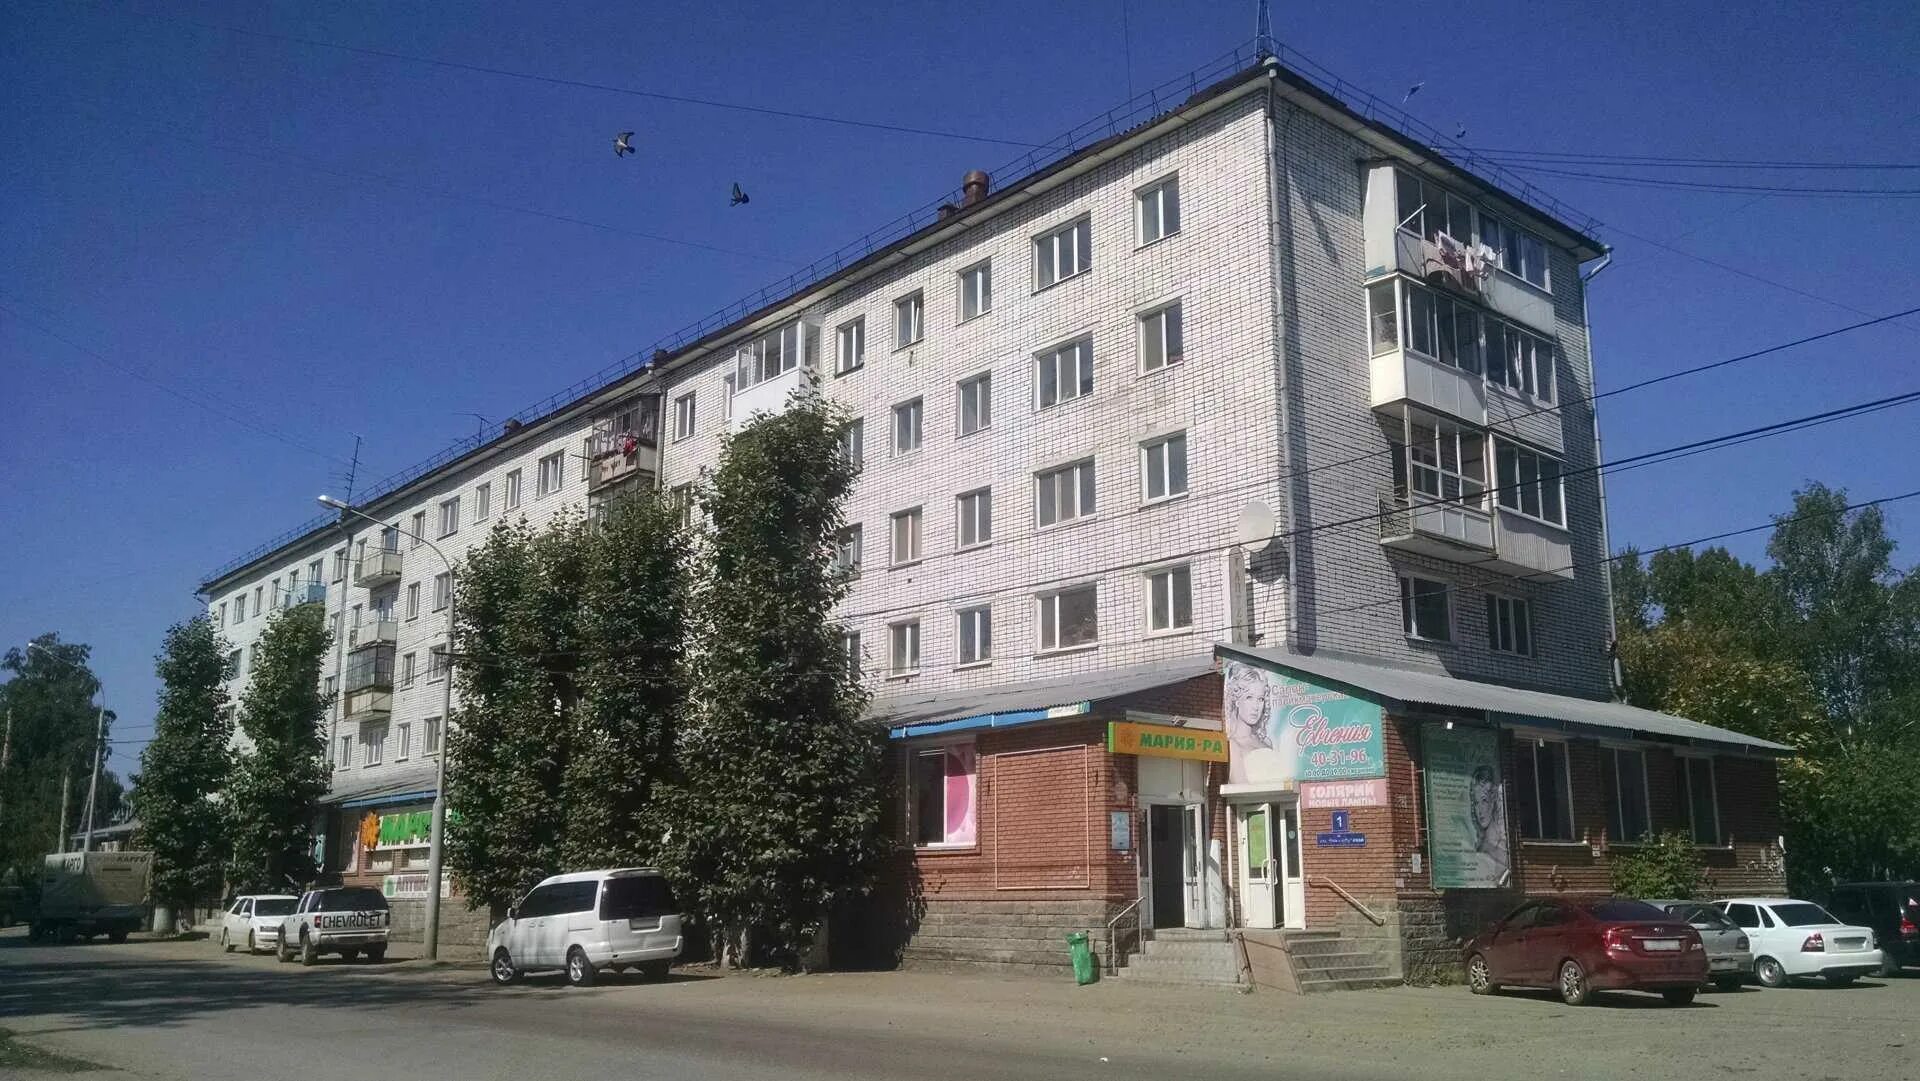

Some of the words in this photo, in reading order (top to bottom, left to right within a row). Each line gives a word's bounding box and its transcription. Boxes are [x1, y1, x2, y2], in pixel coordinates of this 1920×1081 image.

[1288, 704, 1373, 757] Евгения
[1140, 733, 1223, 753] МАРИЯ-РА
[1311, 749, 1368, 767] 40-31-96
[1310, 781, 1376, 799] СОЛЯРИЙ
[1336, 815, 1342, 828] 1
[323, 912, 381, 929] CHEVROLET
